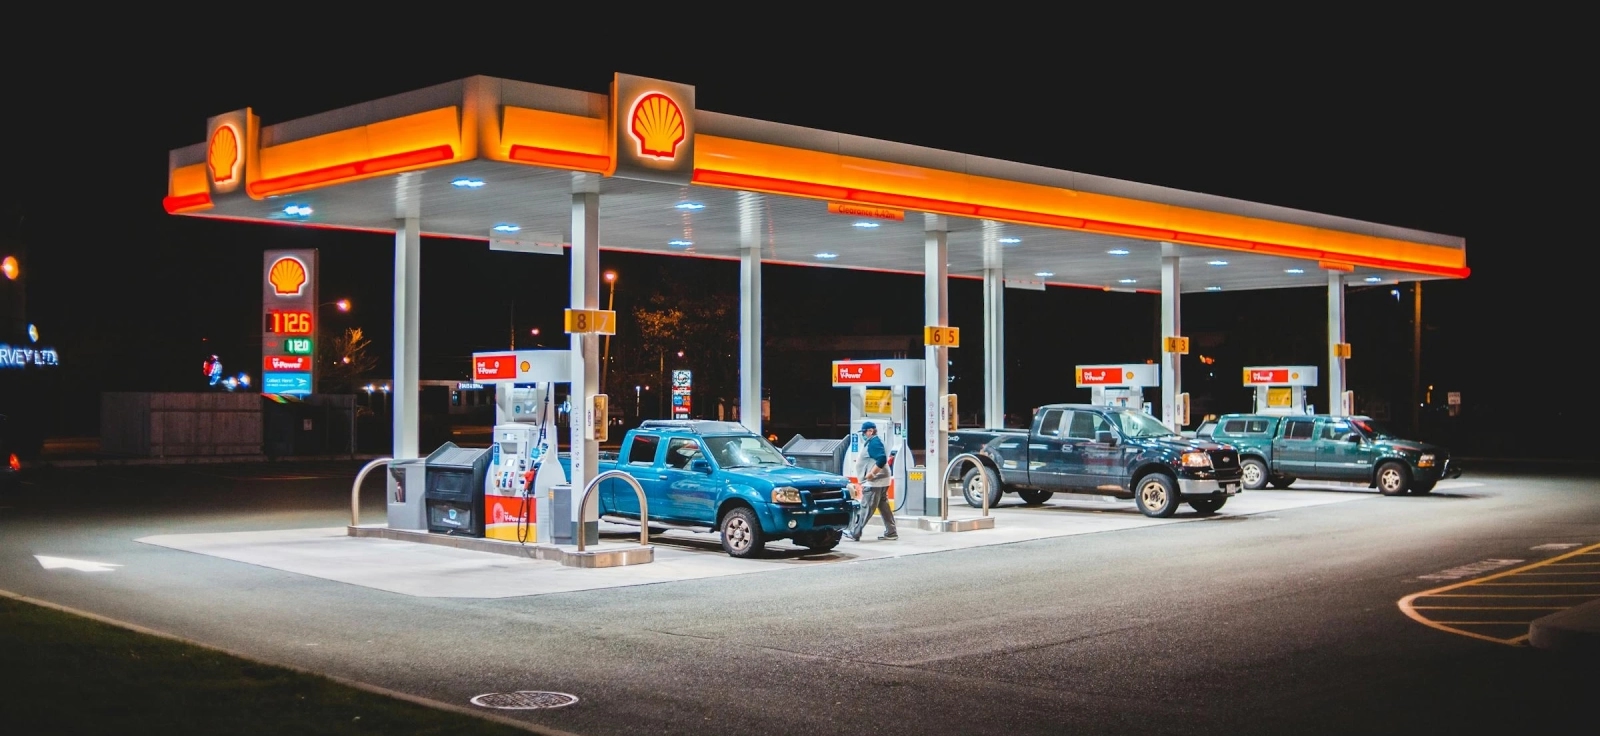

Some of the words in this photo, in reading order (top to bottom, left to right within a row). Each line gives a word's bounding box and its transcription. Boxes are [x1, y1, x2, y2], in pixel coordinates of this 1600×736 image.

[838, 205, 873, 217] Clearance
[577, 313, 587, 330] 8
[599, 314, 608, 331] 7
[934, 330, 941, 343] 6
[949, 330, 955, 344] 5
